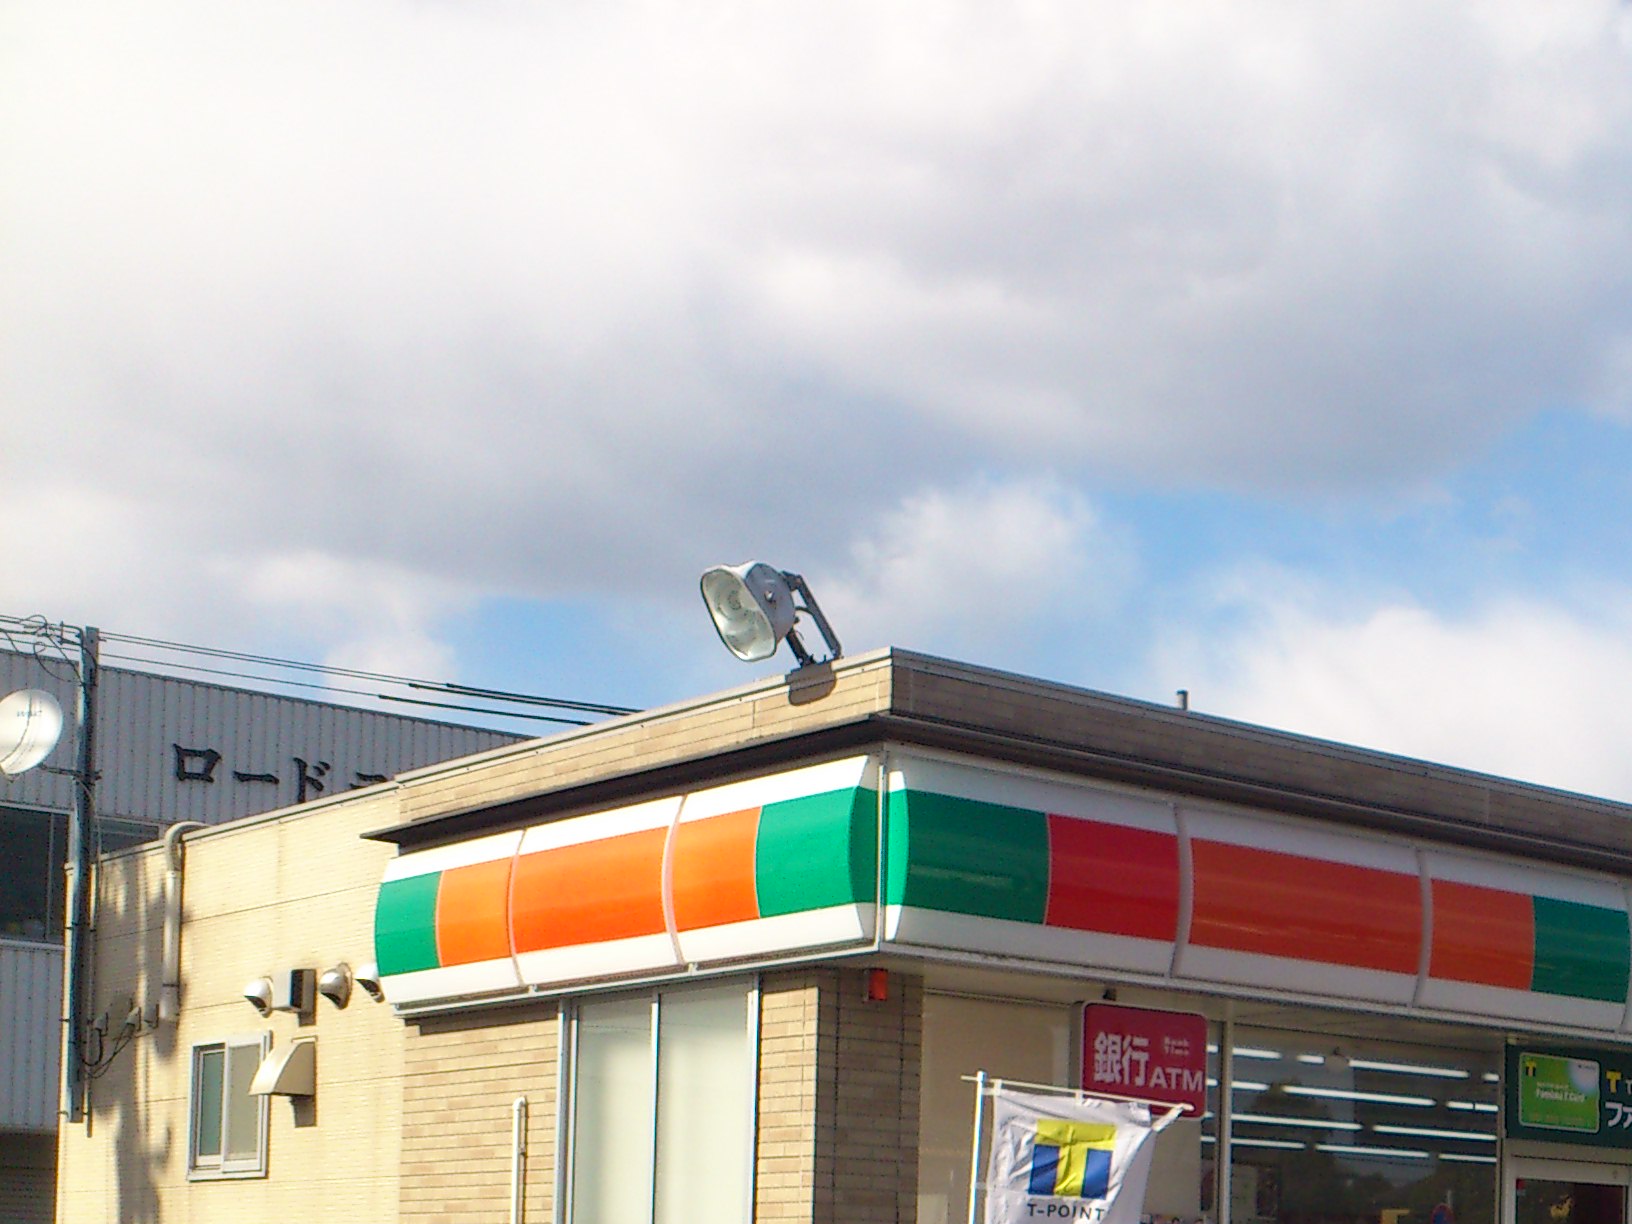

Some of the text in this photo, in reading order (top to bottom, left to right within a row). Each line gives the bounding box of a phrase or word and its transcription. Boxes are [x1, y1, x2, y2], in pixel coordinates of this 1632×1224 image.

[1094, 1031, 1204, 1092] 銀行 ATM
[1027, 1203, 1106, 1221] T-POINT
